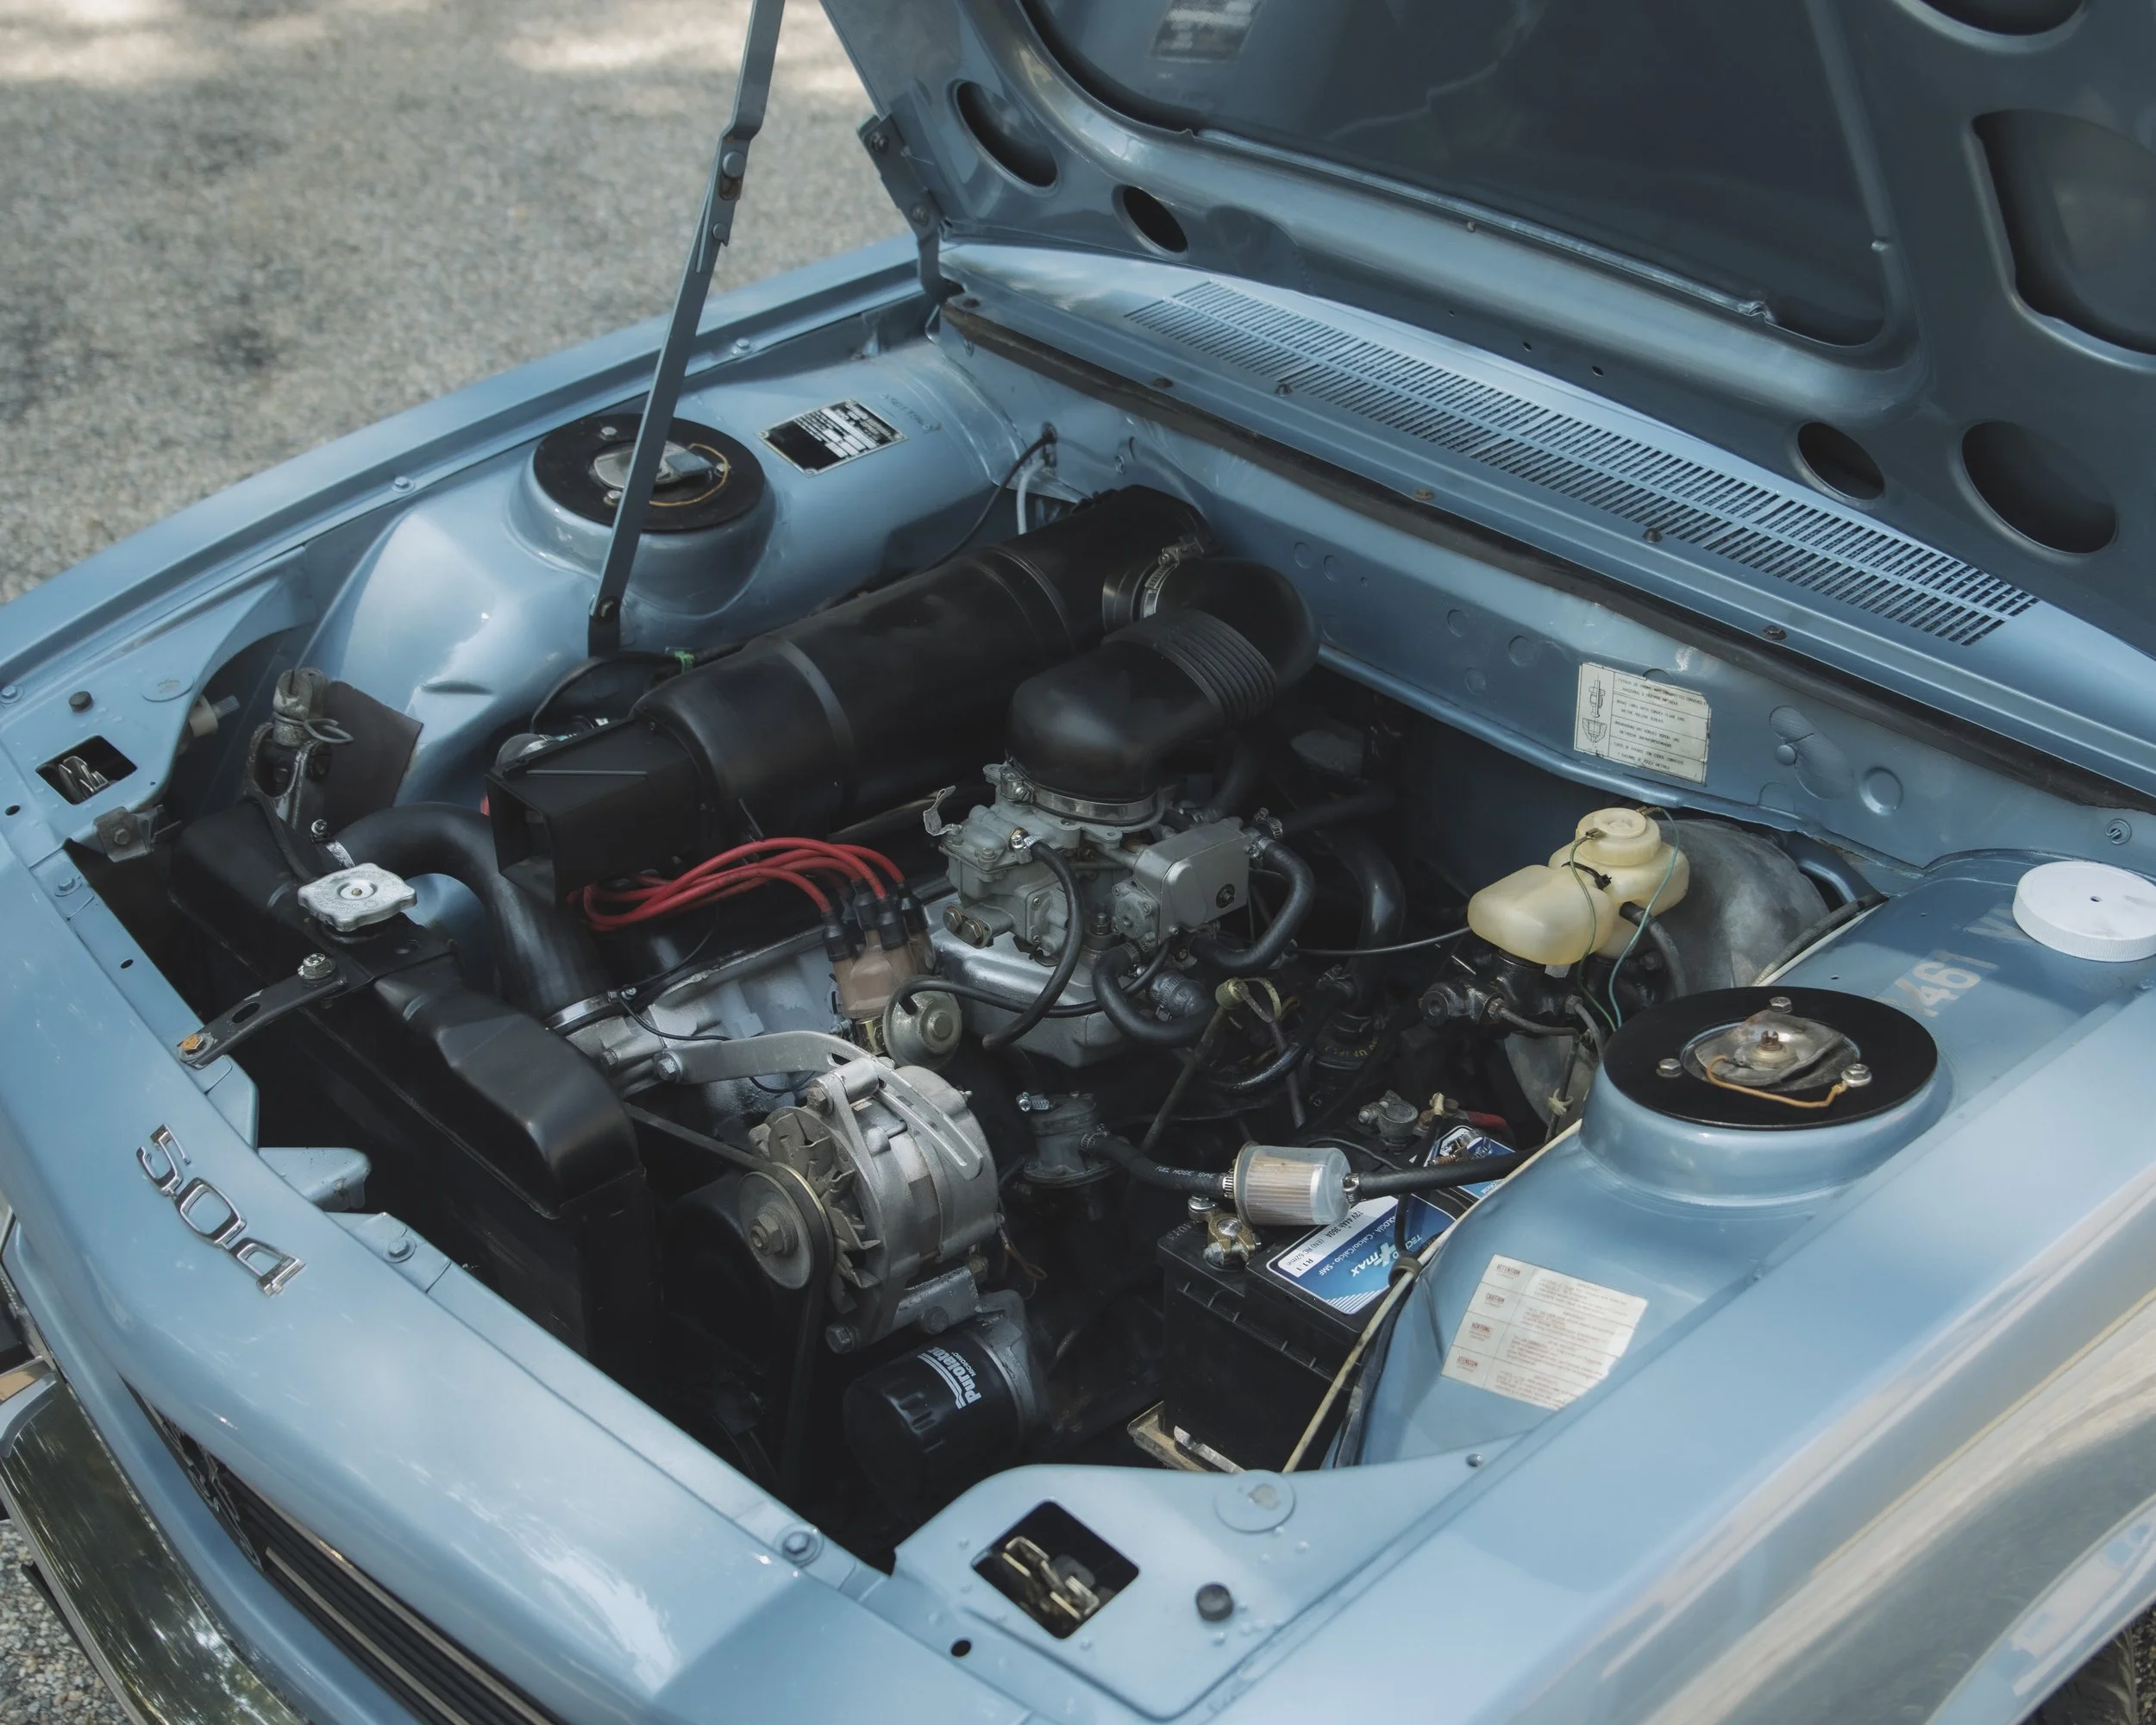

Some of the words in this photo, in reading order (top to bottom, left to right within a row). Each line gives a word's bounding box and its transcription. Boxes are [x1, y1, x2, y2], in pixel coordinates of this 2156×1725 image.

[136, 1123, 308, 1296] 504
[1351, 1210, 1364, 1221] 12V
[1338, 1216, 1354, 1228] 44Ah
[1325, 1226, 1342, 1239] 360A
[1310, 1238, 1326, 1249] (EN)
[1334, 1233, 1374, 1264] Calcio/Calcio
[1319, 1264, 1333, 1276] SMF
[1485, 1293, 1506, 1304] CAUTION
[927, 1346, 981, 1404] Purolator
